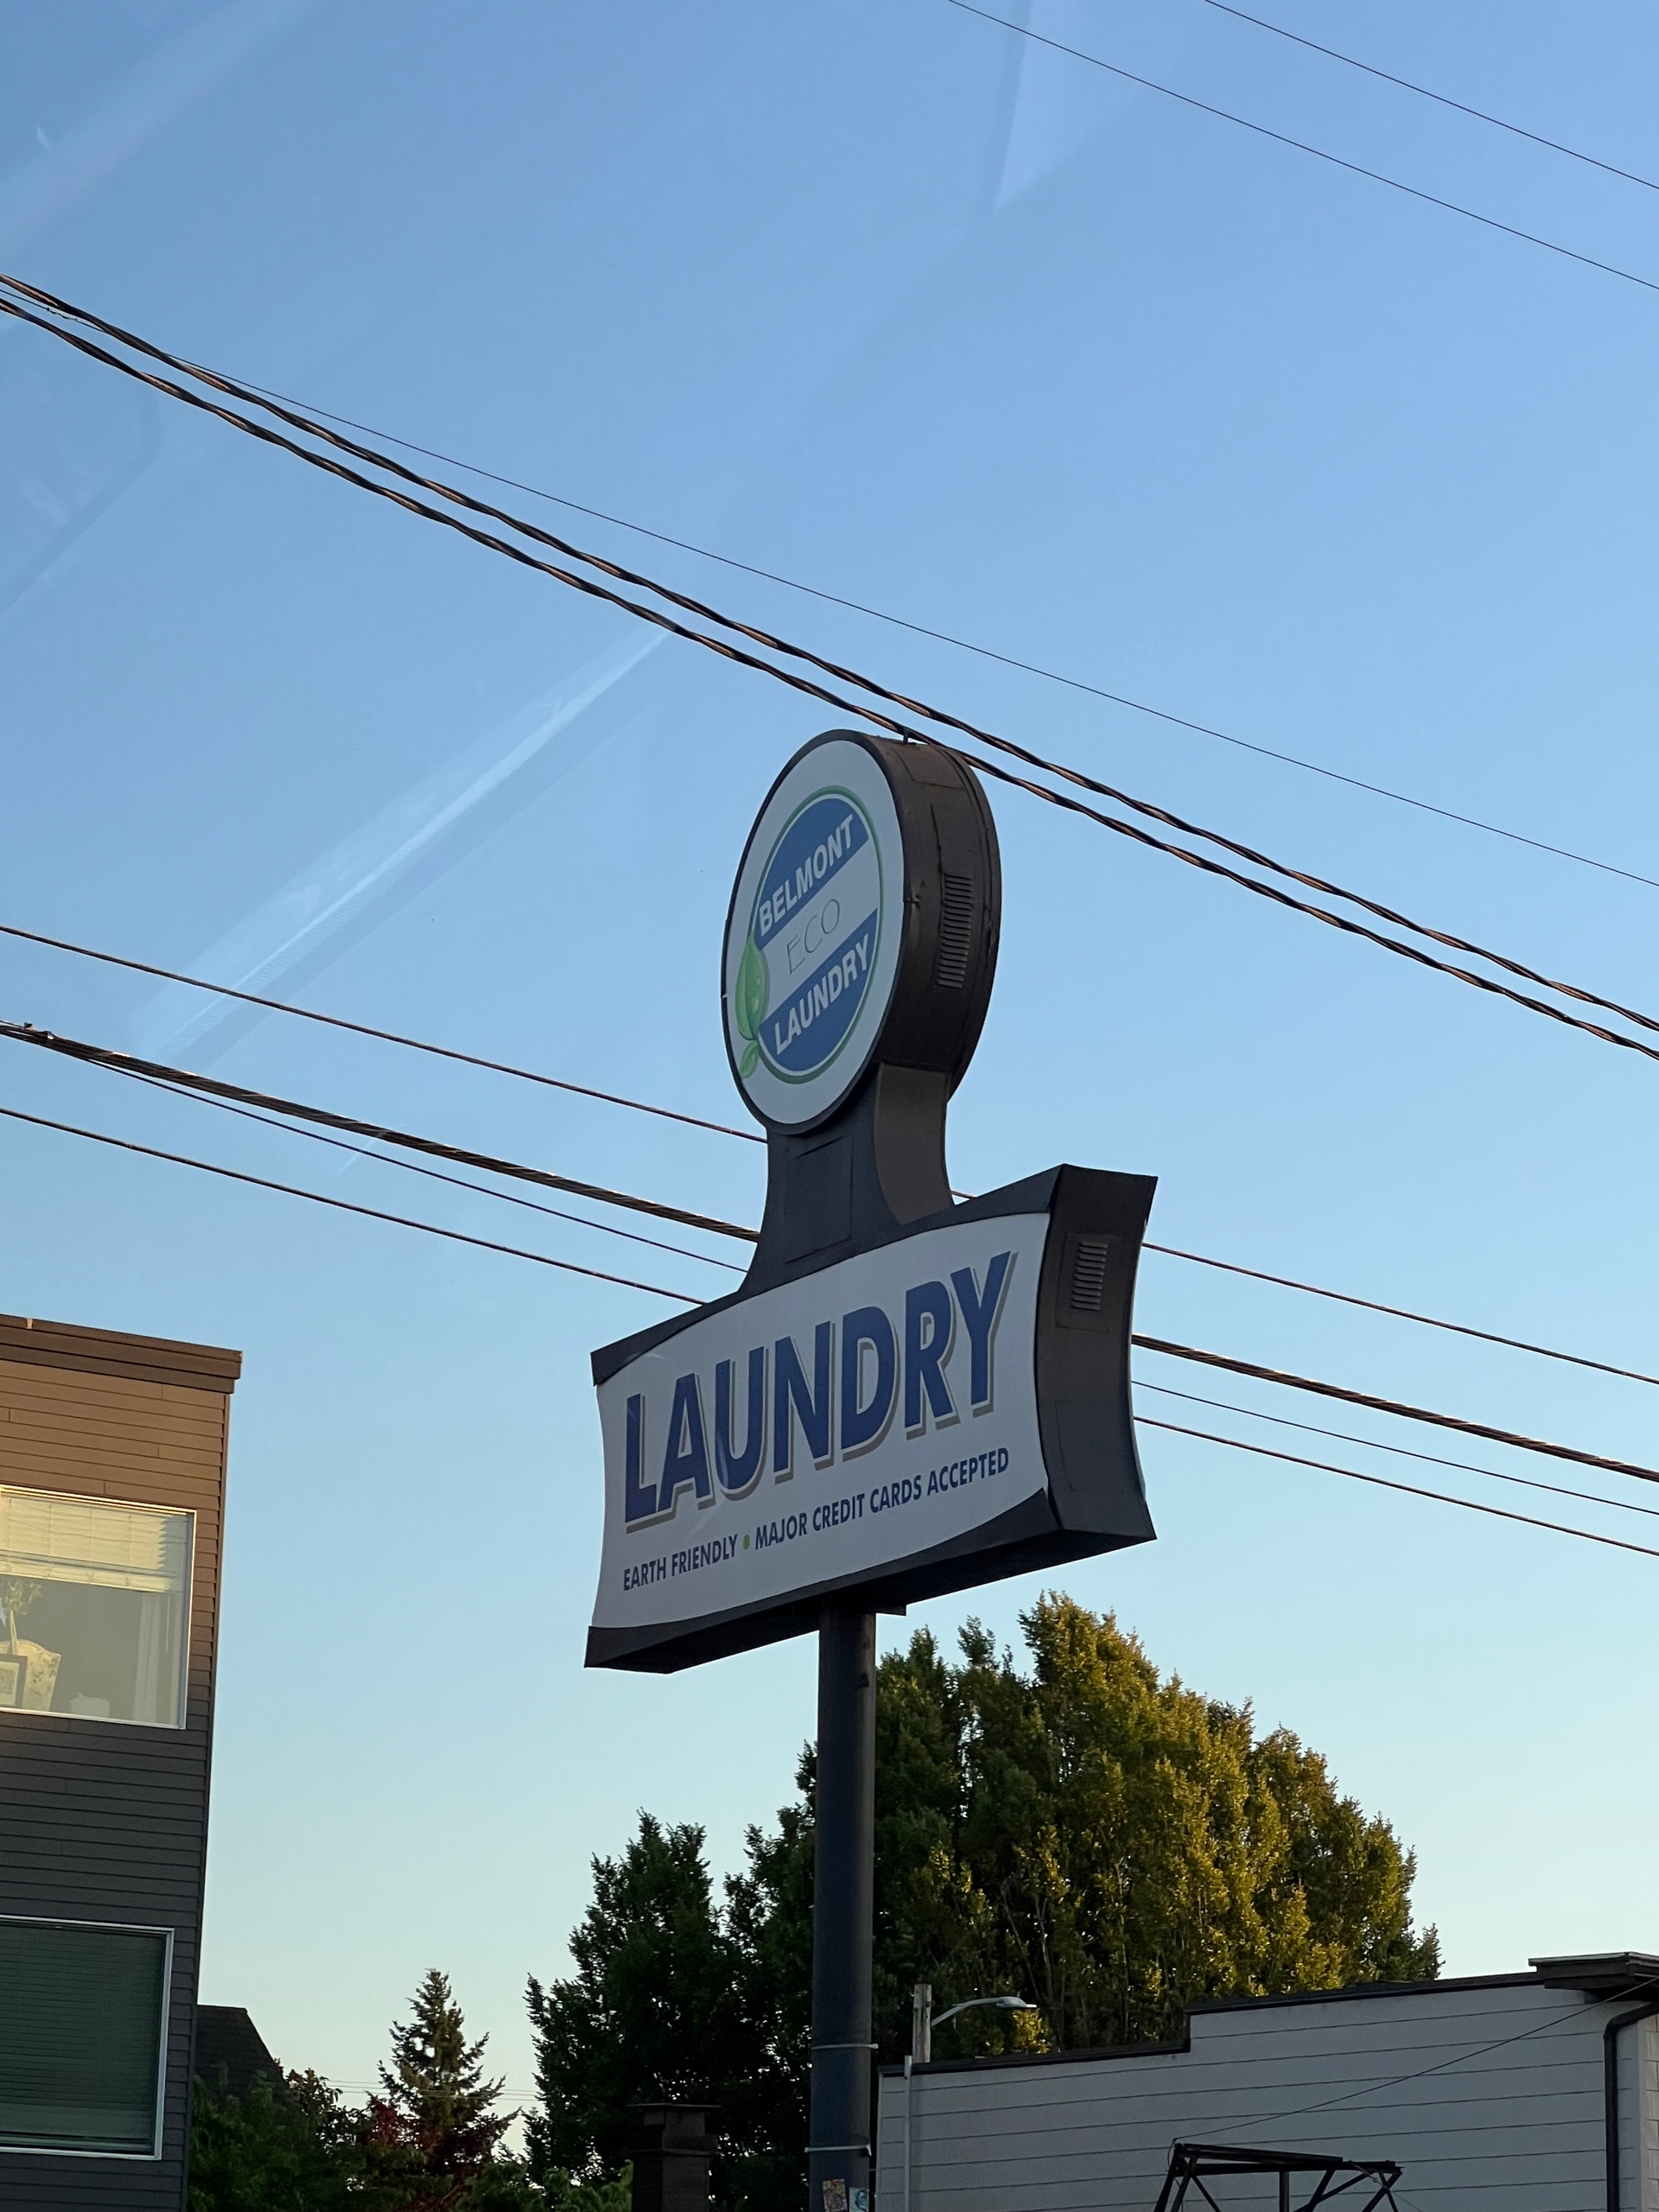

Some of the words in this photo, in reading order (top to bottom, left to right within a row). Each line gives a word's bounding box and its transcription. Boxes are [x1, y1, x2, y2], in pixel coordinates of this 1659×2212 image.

[757, 813, 856, 937] BELMONT
[786, 899, 841, 974] ECO
[772, 934, 872, 1055] LAUNDRY
[625, 1250, 1018, 1534] LAUNDRY
[623, 1556, 667, 1591] EARTH
[671, 1534, 739, 1577] FRIENDLY
[754, 1512, 807, 1550] MAJOR
[812, 1494, 865, 1532] CREDIT
[869, 1474, 922, 1514] CARDS
[926, 1447, 1009, 1497] ACCEPTED
